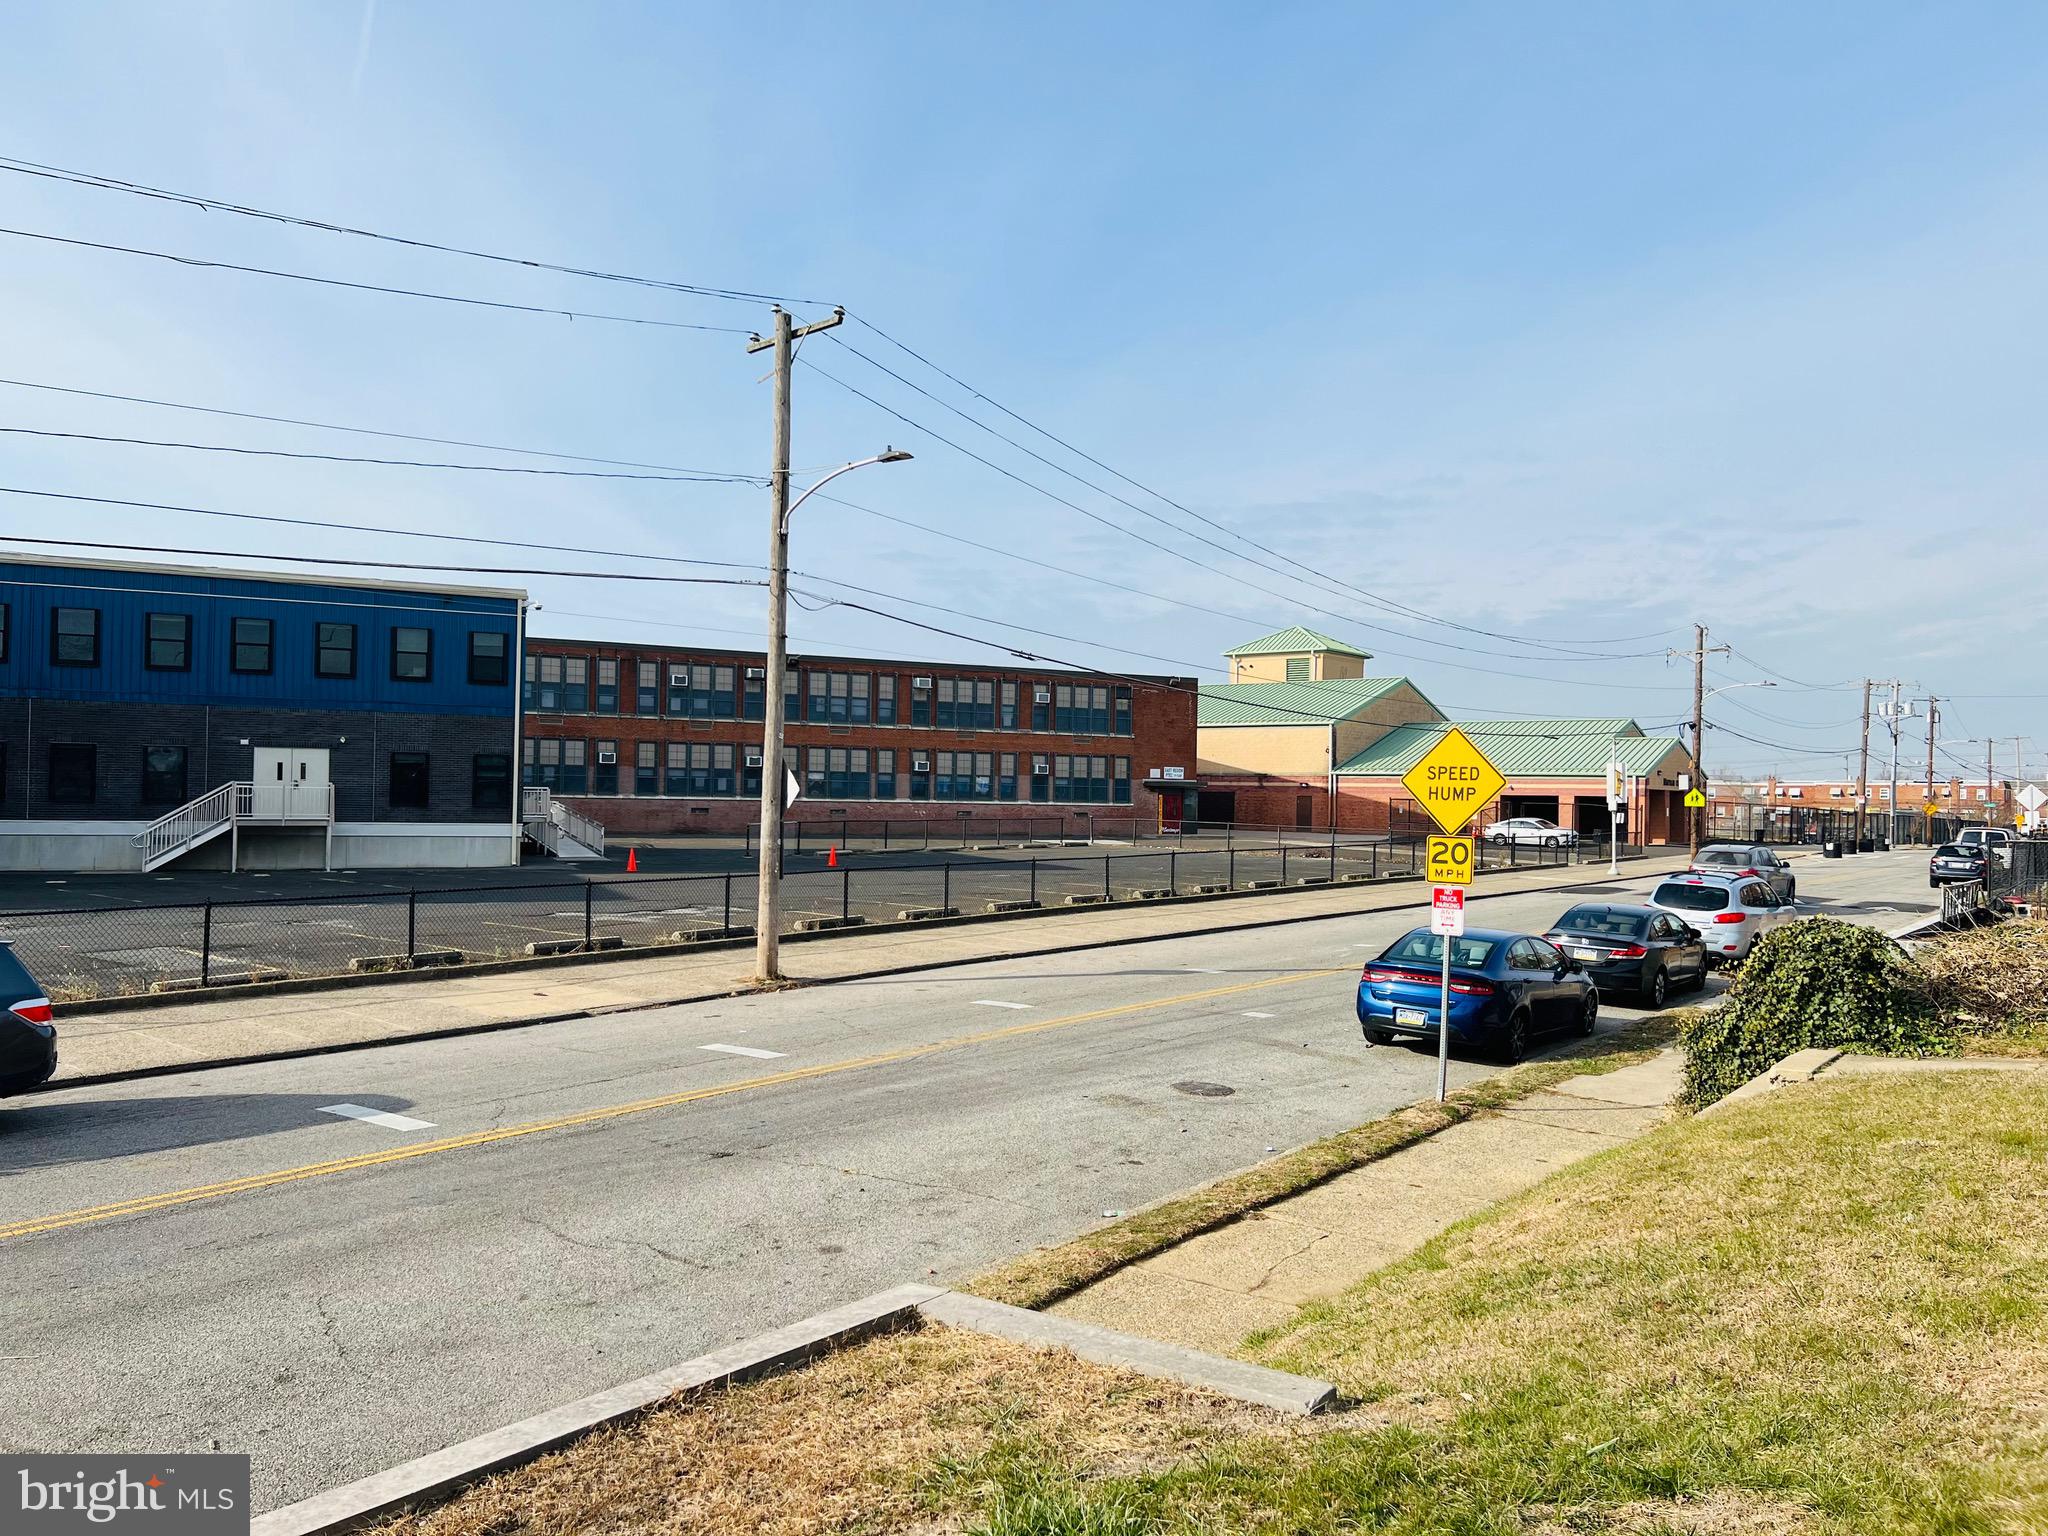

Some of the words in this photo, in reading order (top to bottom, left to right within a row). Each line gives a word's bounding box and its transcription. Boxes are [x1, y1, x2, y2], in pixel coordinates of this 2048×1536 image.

[1427, 766, 1480, 780] SPEED
[1428, 786, 1477, 801] HUMP
[1432, 842, 1469, 865] 20
[1435, 869, 1464, 878] MPH
[1435, 901, 1461, 909] PARKING
